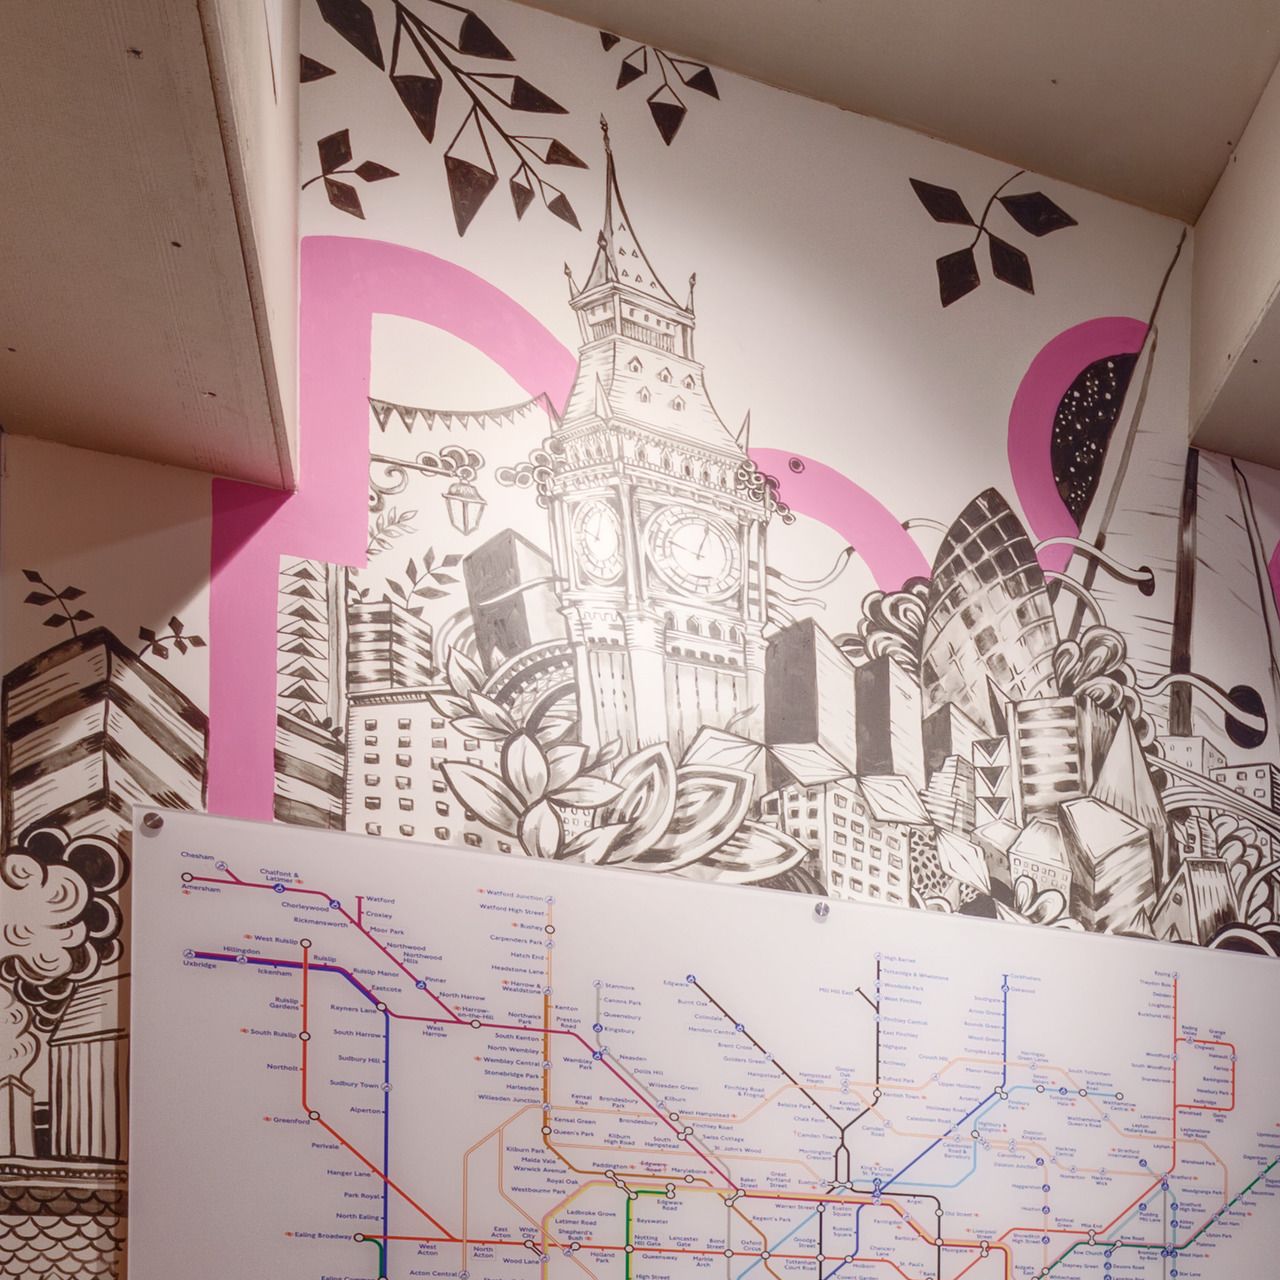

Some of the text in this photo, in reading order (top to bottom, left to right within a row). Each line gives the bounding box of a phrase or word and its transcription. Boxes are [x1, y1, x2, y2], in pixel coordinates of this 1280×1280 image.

[180, 852, 214, 861] Chesham
[260, 868, 292, 878] Chalfont
[266, 876, 293, 884] Latimer
[182, 884, 221, 894] Amersham
[366, 896, 395, 904] Watford
[282, 902, 330, 913] Chorleywood
[366, 910, 392, 920] Croxley
[294, 917, 348, 928] Rickmansworth
[370, 926, 404, 936] Moor Park
[254, 934, 298, 946] West Ruislip
[223, 946, 260, 956] Hillingdon
[386, 942, 426, 952] Northwood
[183, 960, 216, 970] Uxbridge
[258, 968, 292, 977] Ickenham
[354, 967, 399, 978] Ruislip Manor
[372, 985, 402, 993] Eastcote
[330, 1004, 358, 1014] Rayners
[272, 1031, 297, 1040] Ruislip
[355, 1031, 381, 1039] Harrow
[495, 1032, 516, 1040] South
[488, 1044, 540, 1056] North Wembley
[338, 1054, 380, 1064] Sudbury Hill
[484, 1057, 540, 1068] Wembley Central
[267, 1064, 298, 1072] Northolt
[484, 1070, 539, 1080] Stonebridge Park
[330, 1079, 379, 1090] Sudbury Town
[506, 1084, 540, 1092] Harlesden
[350, 1106, 381, 1116] Alperton
[273, 1116, 310, 1126] Greenford
[312, 1142, 340, 1150] Perivale
[592, 1162, 628, 1171] Paddington
[327, 1169, 371, 1178] Hanger Lane
[362, 1193, 380, 1202] Royal
[336, 1212, 380, 1222] North Ealing
[519, 1226, 538, 1234] White
[294, 1232, 352, 1242] Ealing Broadway
